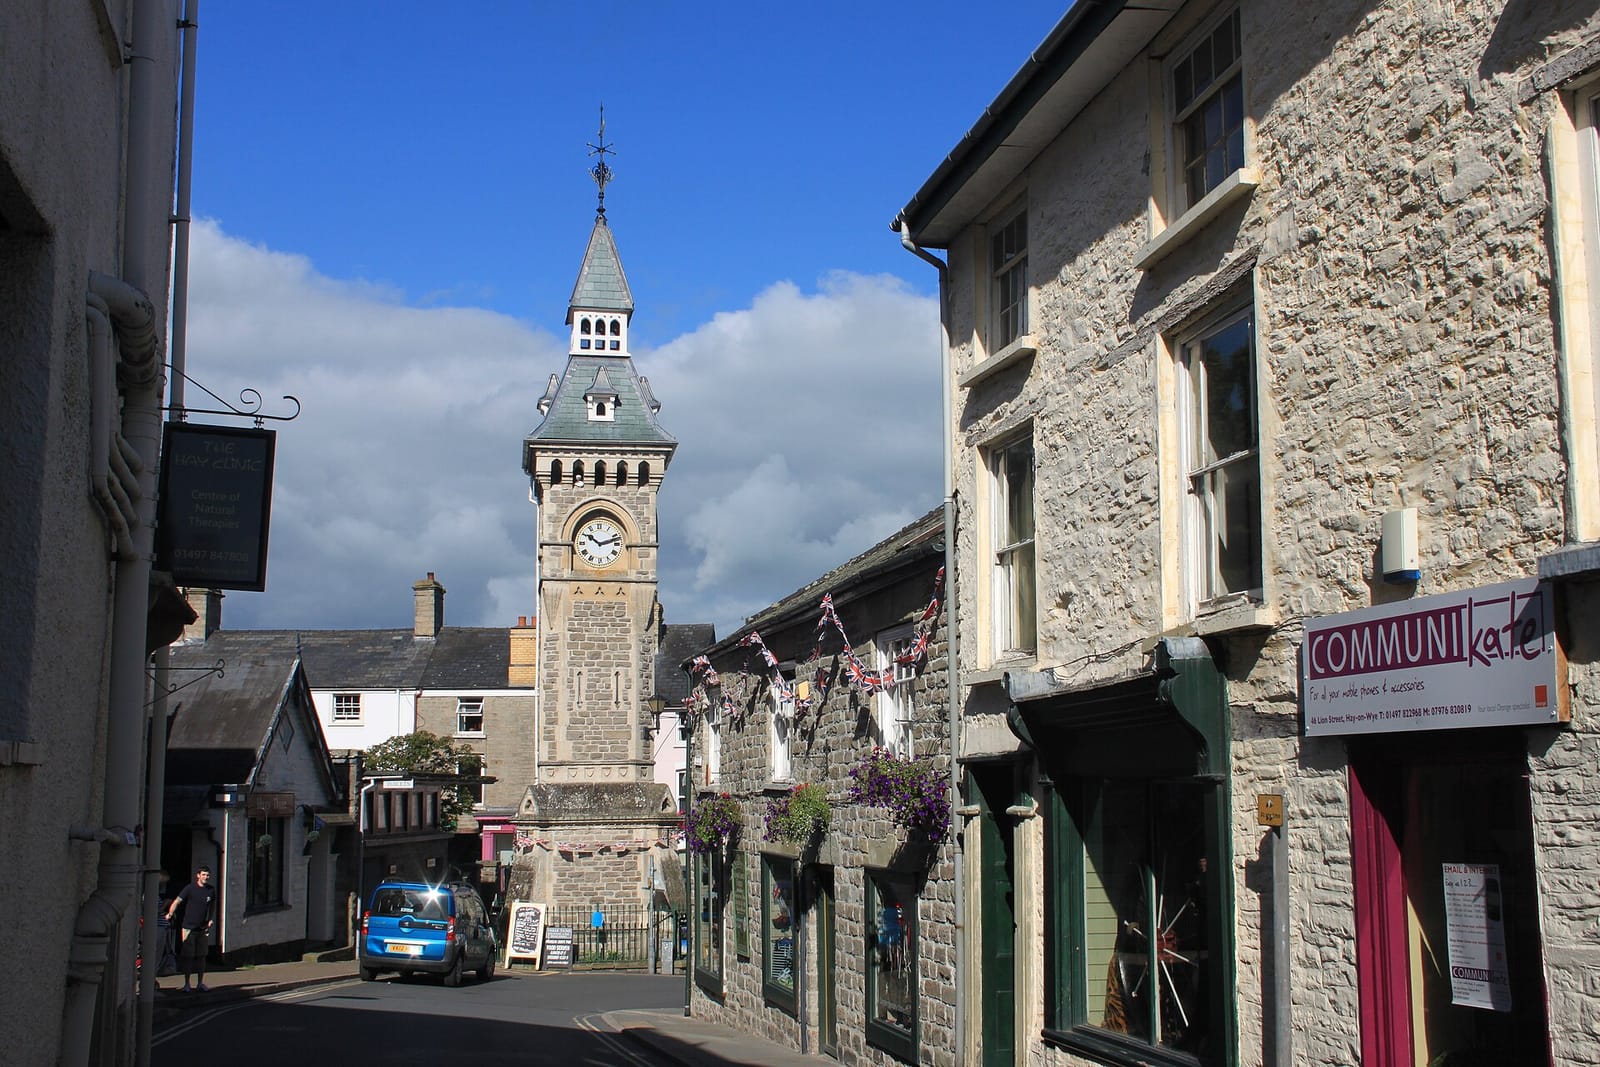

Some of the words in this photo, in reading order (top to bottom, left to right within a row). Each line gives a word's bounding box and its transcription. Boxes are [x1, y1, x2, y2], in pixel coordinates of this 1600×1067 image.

[203, 441, 236, 454] THE
[175, 453, 209, 468] HAY
[191, 489, 226, 502] Centre
[230, 491, 241, 502] of
[194, 503, 236, 515] Natural
[188, 516, 241, 530] Therapies
[174, 548, 207, 561] 01497
[1309, 685, 1319, 701] For
[1329, 689, 1340, 704] your
[1342, 681, 1358, 698] mobile
[1360, 683, 1380, 702] phones
[1391, 676, 1425, 693] accessories
[1317, 716, 1328, 725] Lion
[1345, 711, 1378, 724] Hay-on-Wye
[1379, 711, 1385, 719] T:
[1385, 709, 1401, 719] 01497
[1431, 705, 1449, 716] 07976
[1449, 704, 1472, 715] 820819
[1444, 865, 1463, 874] EMAIL
